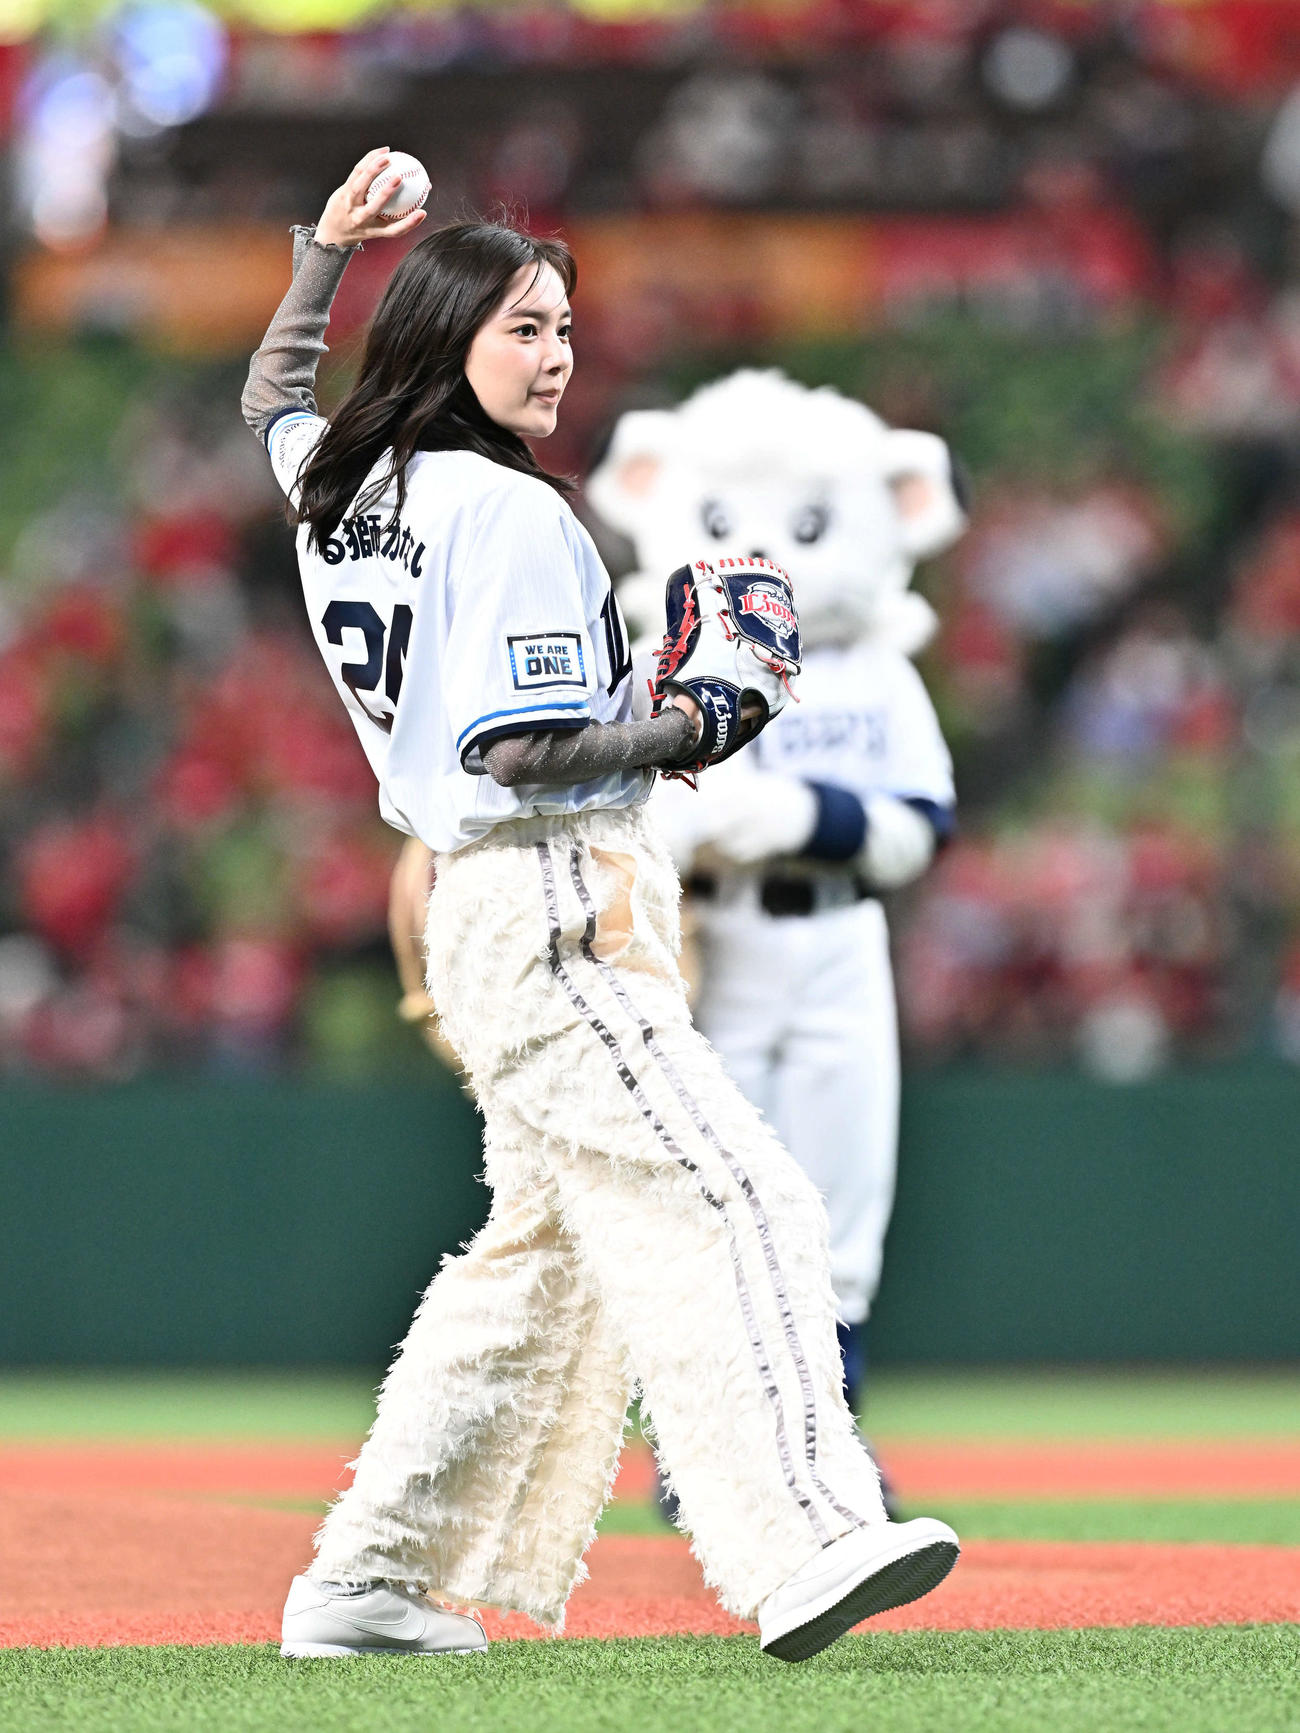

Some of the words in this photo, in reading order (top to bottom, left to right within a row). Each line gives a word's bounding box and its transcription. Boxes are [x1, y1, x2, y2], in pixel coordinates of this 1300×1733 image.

[525, 645, 544, 655] WE
[547, 645, 568, 655] ARE
[525, 656, 573, 676] ONE
[702, 687, 732, 753] Lions
